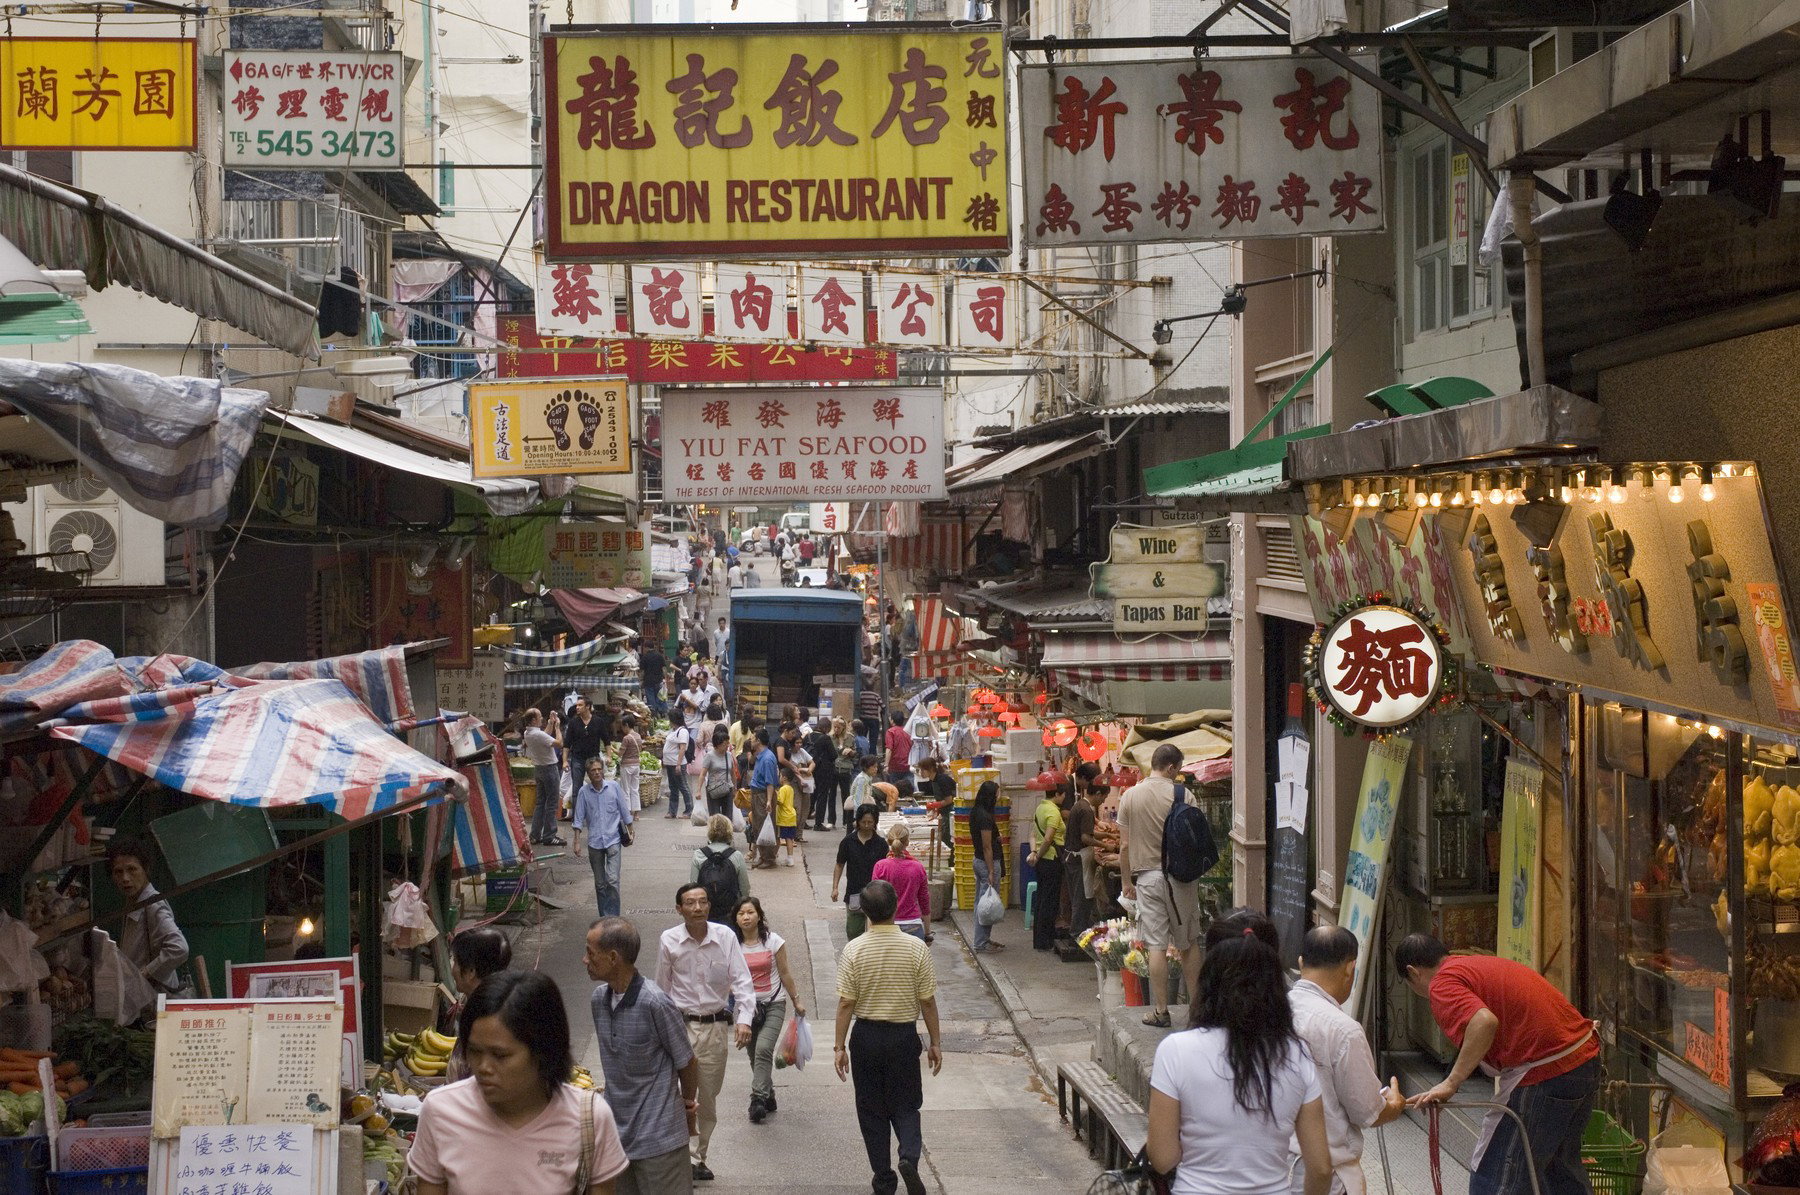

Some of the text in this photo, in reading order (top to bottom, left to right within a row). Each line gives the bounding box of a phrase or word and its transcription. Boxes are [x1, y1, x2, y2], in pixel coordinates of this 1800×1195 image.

[245, 61, 394, 82] 6A G/F 世界 TV.VCR
[17, 66, 176, 121] 蘭芳園
[231, 85, 393, 122] 修理電視
[566, 47, 951, 151] 龍記飯店
[1043, 66, 1361, 163] 新景記
[229, 130, 396, 157] TEL 2 545 3473
[569, 176, 953, 226] DRAGON RESTAURANT
[551, 264, 1006, 343] 蘇記肉食公司
[702, 397, 904, 430] 耀發海鮮
[493, 402, 511, 462] 古法足道
[607, 405, 618, 462] 2543 1002
[680, 435, 927, 457] YIU FAT SEAFOOD
[527, 452, 554, 460] Opening
[676, 484, 932, 498] THE BEST OF INTERNATIONAL FRESH SEAFOOD PRODUCT
[1139, 537, 1177, 555] Wine
[1152, 570, 1166, 588] &
[1121, 604, 1201, 623] Tapas Bar
[1333, 618, 1435, 716] 麵
[193, 1131, 301, 1156] 優惠快餐
